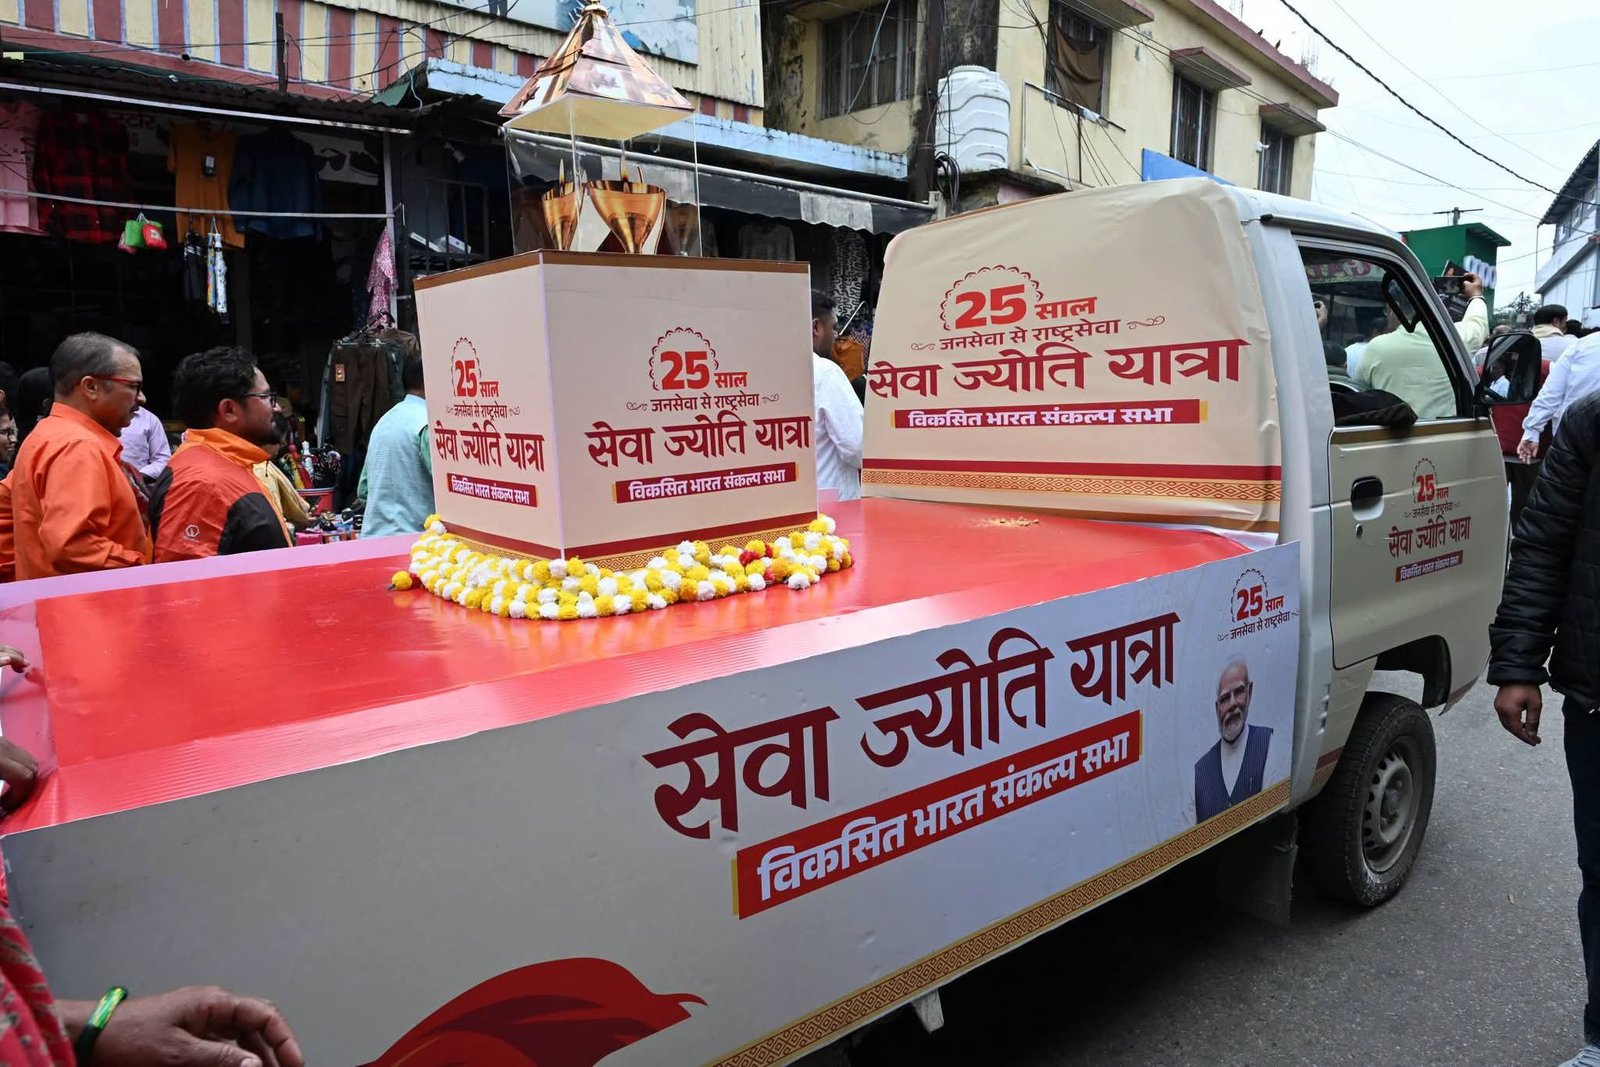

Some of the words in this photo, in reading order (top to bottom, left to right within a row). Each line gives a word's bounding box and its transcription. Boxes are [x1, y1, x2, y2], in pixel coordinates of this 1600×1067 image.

[954, 284, 1027, 329] 25
[1035, 297, 1098, 319] साल
[939, 330, 1004, 351] जनसेवा
[1011, 325, 1027, 344] से
[1033, 318, 1120, 344] राष्ट्रसेवा
[455, 360, 477, 397] 25
[479, 382, 499, 397] साल
[661, 351, 710, 390] 25
[715, 372, 747, 388] साल
[868, 361, 943, 399] सेवा
[952, 342, 1093, 392] ज्योति
[1105, 339, 1252, 385] यात्रा
[454, 401, 473, 416] जनसेवा
[474, 401, 480, 417] से
[481, 401, 507, 421] राष्ट्रसेवा
[650, 394, 697, 411] जनसेवा
[701, 392, 711, 409] से
[714, 391, 759, 411] राष्ट्रसेवा
[908, 410, 982, 428] विकसित
[986, 410, 1036, 426] भारत
[1041, 406, 1115, 424] संकल्प
[1121, 406, 1173, 423] सभा
[435, 420, 458, 461] सेवा
[460, 420, 501, 467] ज्योति
[505, 433, 545, 472] यात्रा
[585, 421, 655, 467] सेवा
[662, 410, 748, 458] ज्योति
[753, 416, 812, 451] यात्रा
[452, 476, 474, 495] विकसित
[474, 483, 489, 498] भारत
[491, 483, 513, 502] संकल्प
[514, 490, 529, 504] सभा
[629, 478, 688, 500] विकसित
[690, 476, 721, 492] भारत
[724, 472, 761, 488] संकल्प
[763, 469, 785, 482] सभा
[1416, 474, 1435, 502] 25
[1436, 487, 1449, 499] साल
[1389, 526, 1413, 558] सेवा
[1416, 515, 1447, 549] ज्योति
[1450, 516, 1471, 542] यात्रा
[1237, 585, 1262, 621] 25
[1265, 595, 1284, 612] साल
[1230, 623, 1255, 640] जनसेवा
[1257, 617, 1263, 630] से
[1265, 611, 1290, 628] राष्ट्रसेवा
[643, 706, 840, 840] सेवा
[854, 627, 1055, 769] ज्योति
[1065, 612, 1181, 706] यात्रा
[758, 814, 908, 901] विकसित
[913, 785, 987, 838] भारत
[991, 749, 1079, 810] संकल्प
[1082, 732, 1130, 772] सभा
